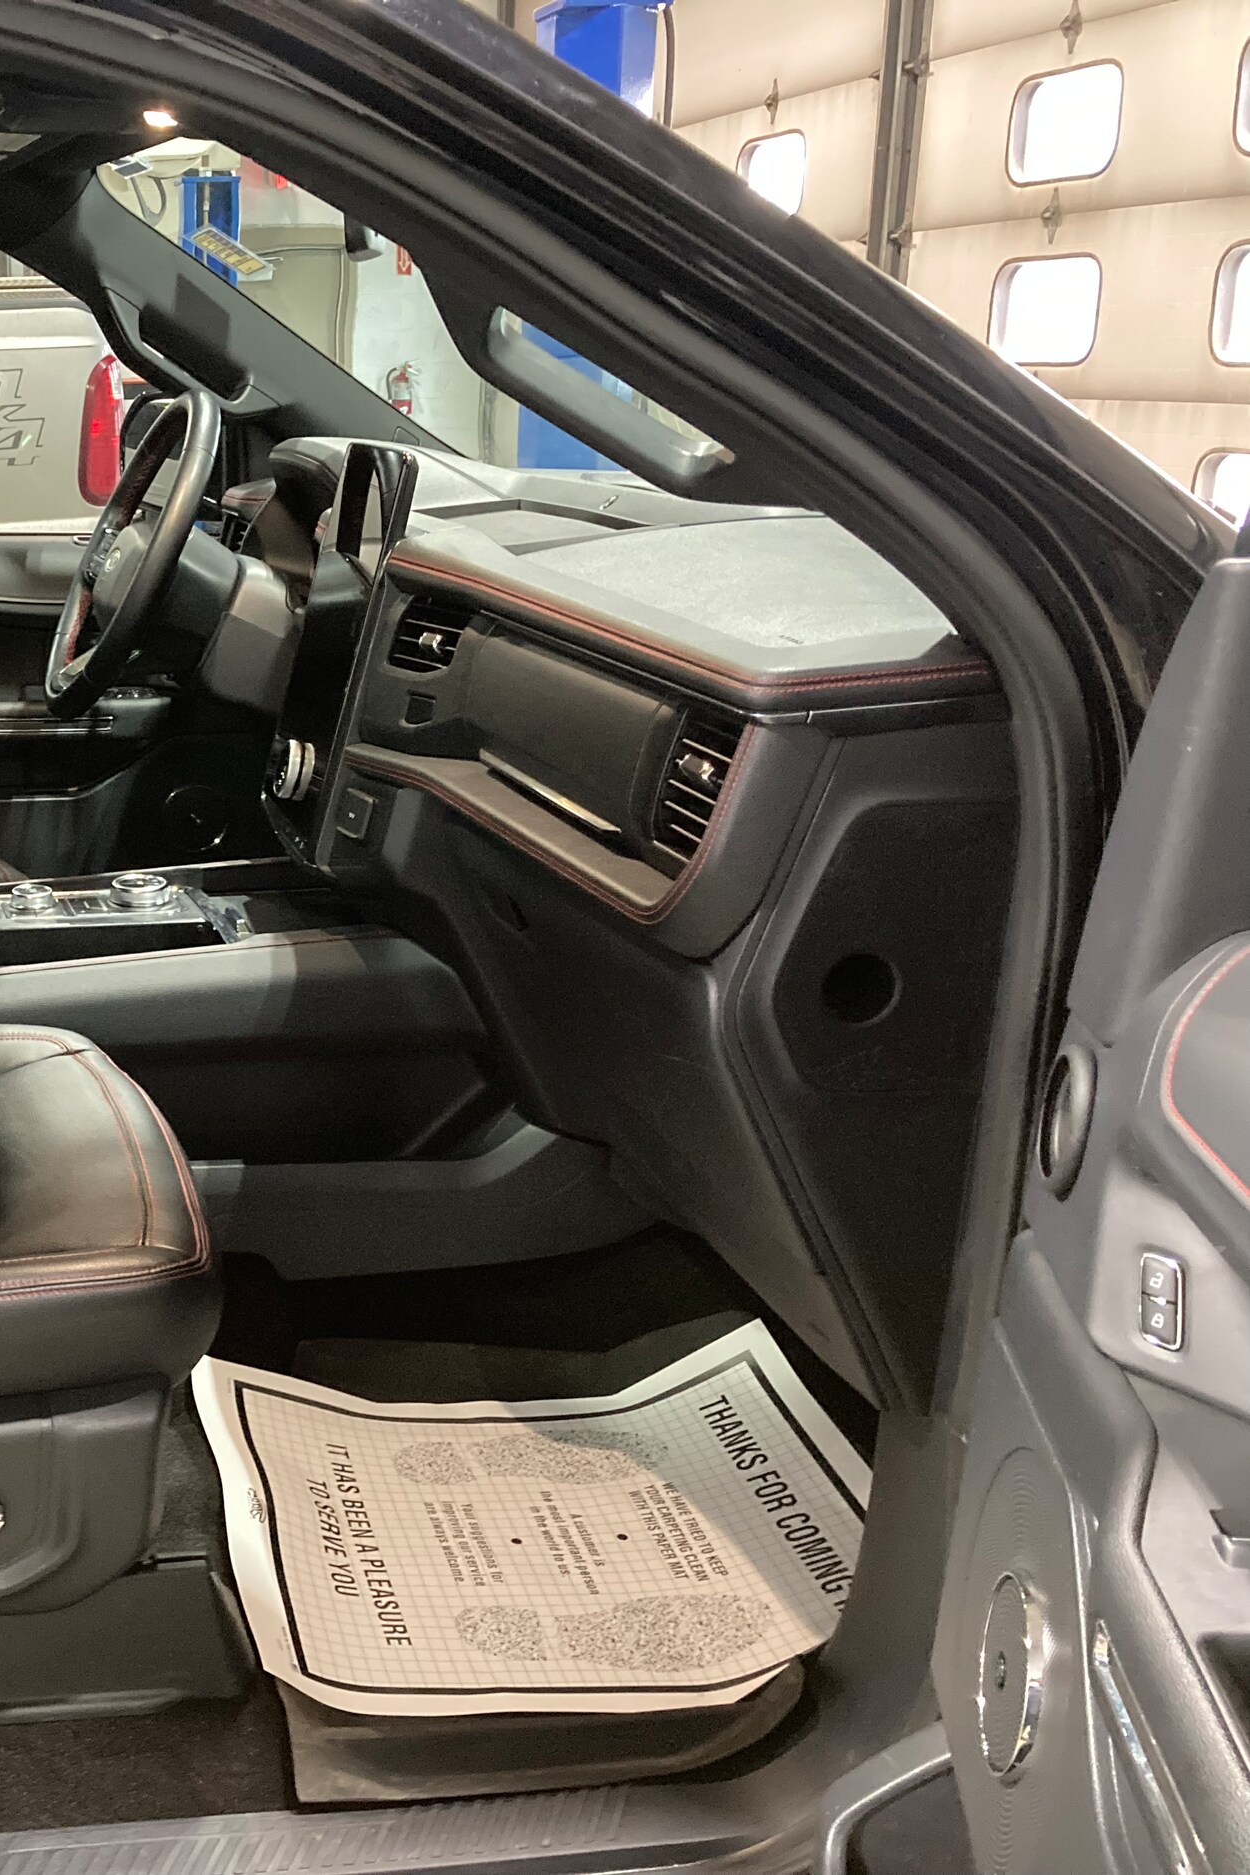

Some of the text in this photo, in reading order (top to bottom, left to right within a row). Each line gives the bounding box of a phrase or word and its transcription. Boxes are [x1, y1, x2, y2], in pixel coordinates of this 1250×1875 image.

[533, 1515, 547, 1528] the
[628, 1490, 690, 1579] WITH THIS PAPER MAT
[643, 1484, 710, 1582] YOUR CARPETING CLEAN
[662, 1481, 729, 1576] WE HAVE TRIED TO KEEP
[699, 1394, 854, 1594] THANKS FOR COMING
[306, 1478, 360, 1598] TO SERVE YOU
[325, 1443, 413, 1647] IT HAS BEEN A PLEASURE
[423, 1502, 465, 1586] are always welcome.
[441, 1501, 487, 1586] improving our service
[460, 1503, 504, 1583] Your suggestions for
[540, 1529, 564, 1551] world
[540, 1490, 600, 1595] the most important person
[553, 1553, 564, 1562] to
[557, 1564, 570, 1577] us.
[573, 1520, 600, 1556] customer
[593, 1559, 606, 1567] is
